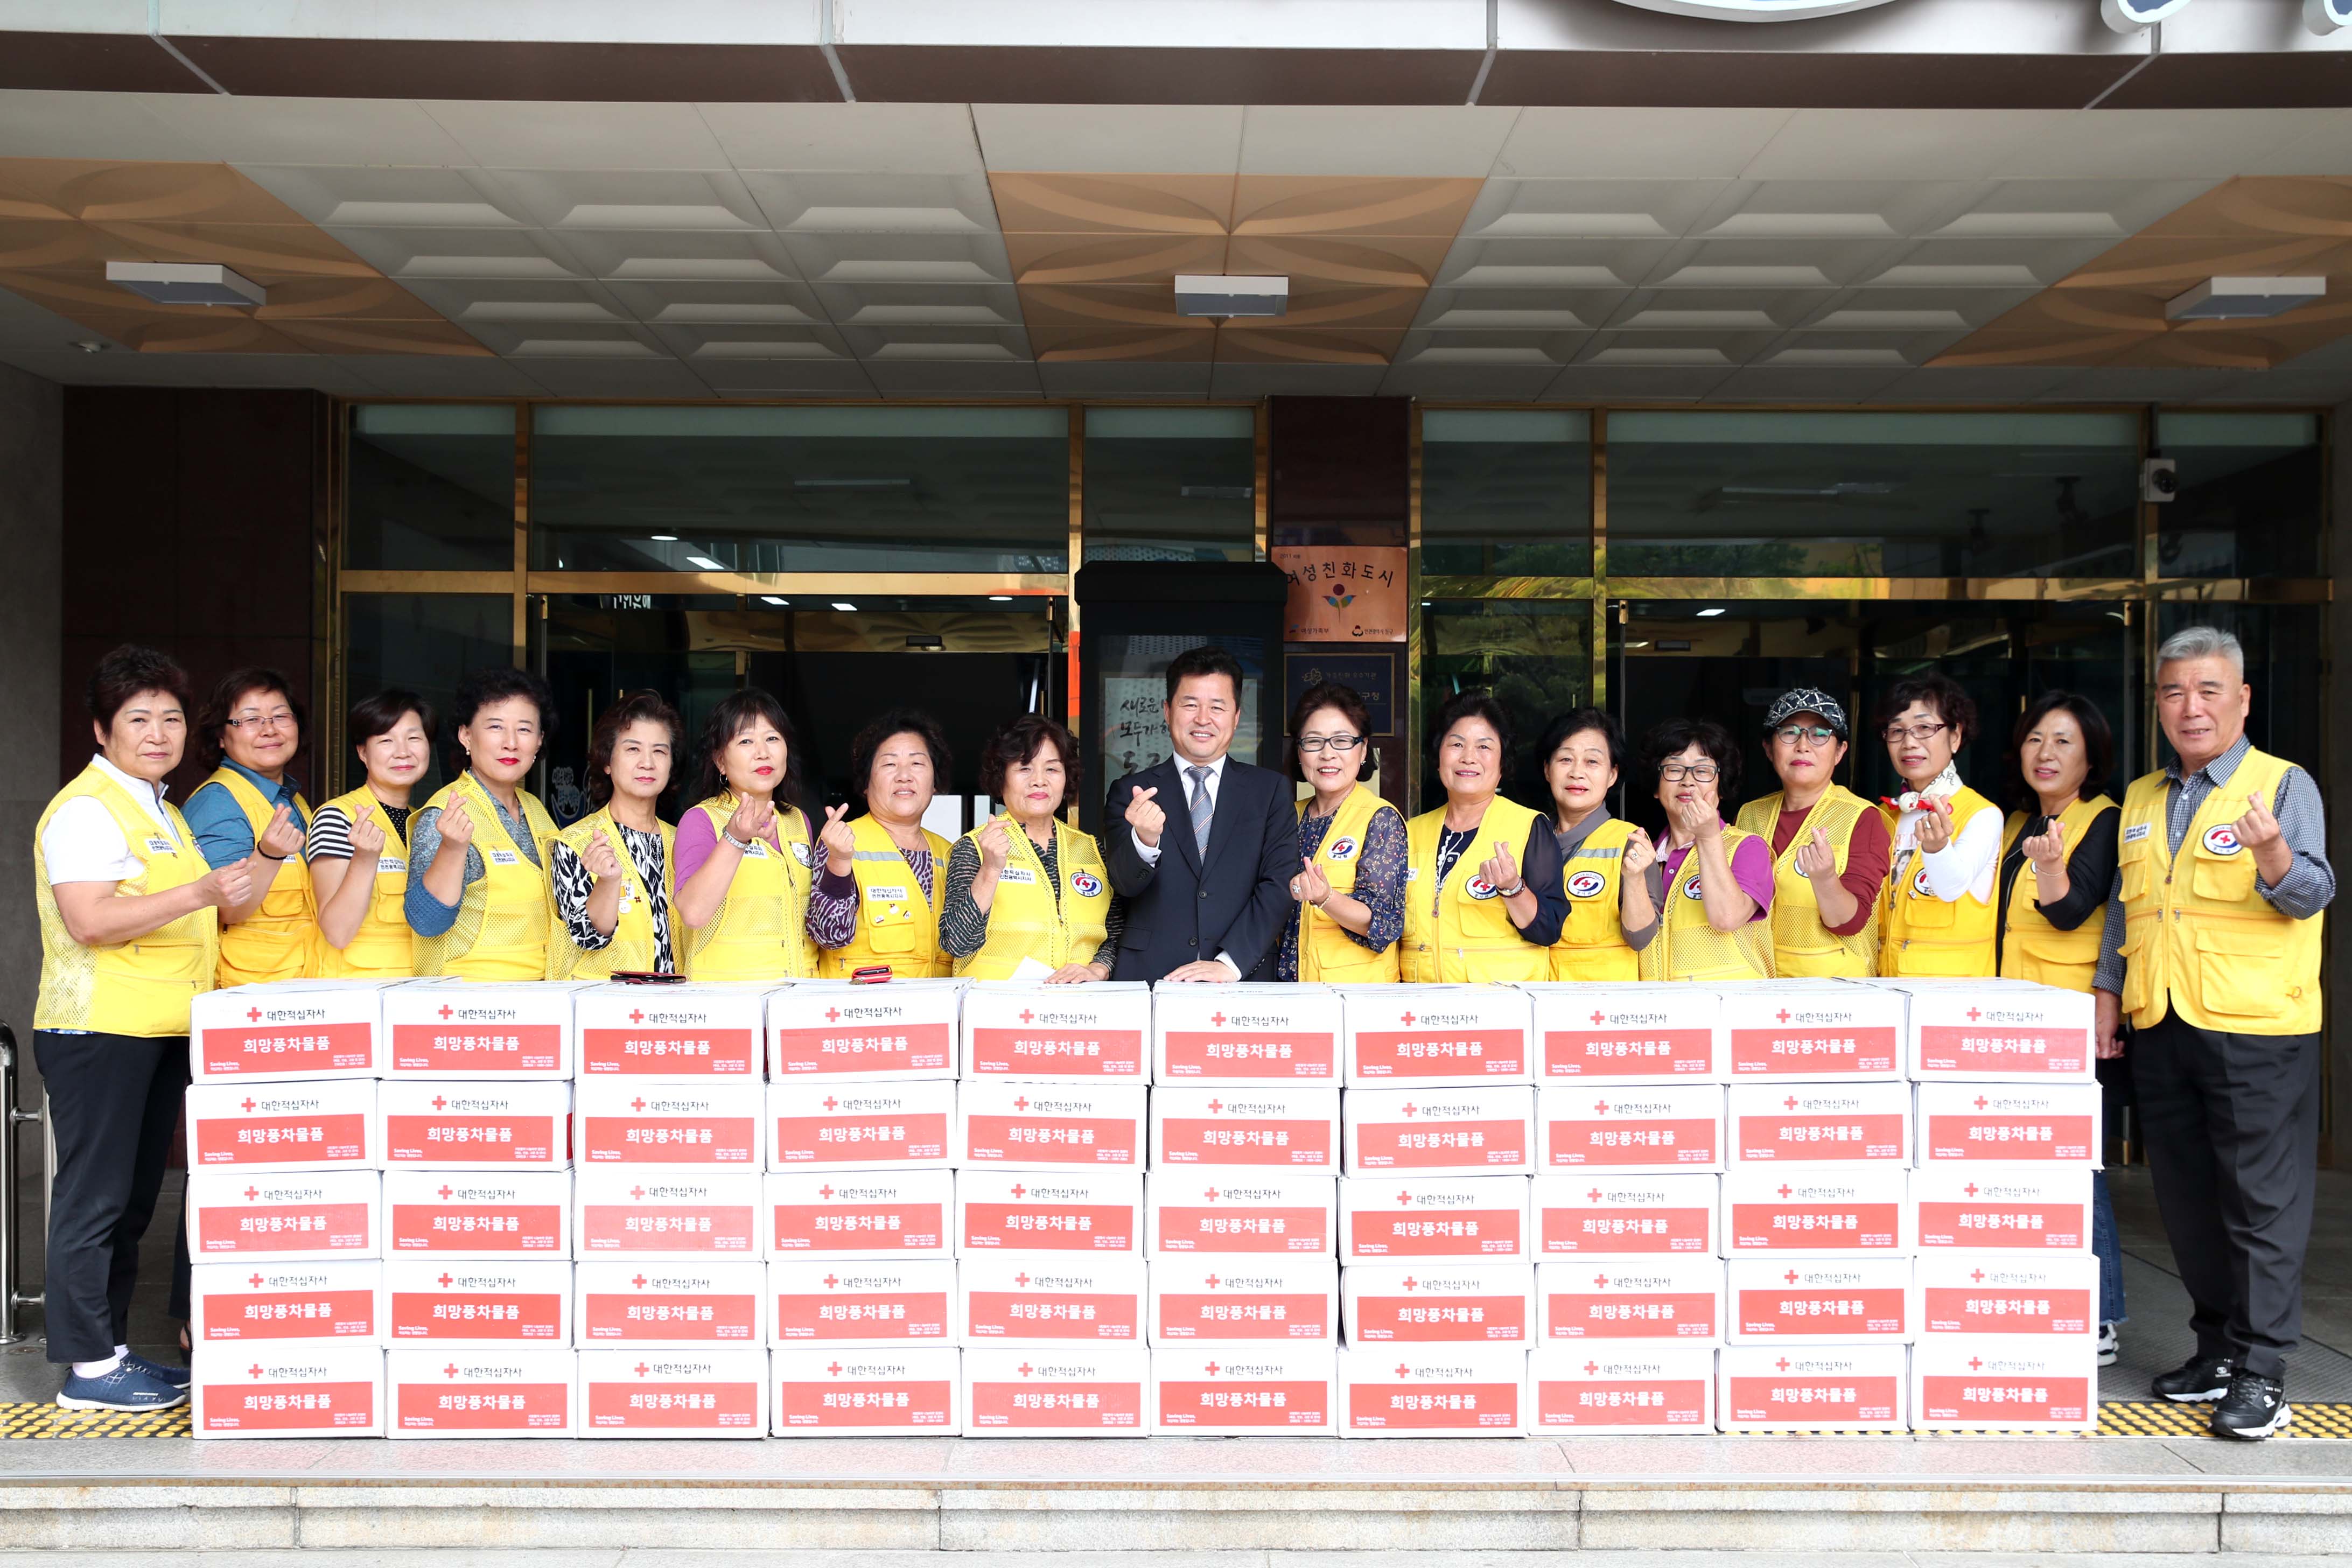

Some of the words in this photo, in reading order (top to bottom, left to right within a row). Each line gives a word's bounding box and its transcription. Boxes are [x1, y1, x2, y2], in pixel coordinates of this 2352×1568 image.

[1286, 561, 1394, 588] 여성친화도시
[1120, 697, 1159, 717] 새로운
[267, 1009, 325, 1021] 대한적십자사
[458, 1009, 516, 1020] 대한적십자사
[649, 1013, 706, 1024] 대한적십자사
[844, 1006, 902, 1019] 대한적십자사
[1039, 1013, 1097, 1024] 대한적십자사
[1421, 1014, 1479, 1025] 대한적십자사
[1610, 1014, 1667, 1024] 대한적십자사
[1796, 1012, 1852, 1023] 대한적십자사
[1986, 1011, 2043, 1021] 대한적십자사
[1231, 1016, 1289, 1026] 대한적십자사
[244, 1037, 330, 1053] 희망풍차물품
[434, 1037, 519, 1051] 희망풍차물품
[625, 1041, 710, 1055] 희망풍차물품
[822, 1037, 908, 1053] 희망풍차물품
[1014, 1040, 1100, 1055] 희망풍차물품
[1207, 1044, 1292, 1058] 희망풍차물품
[1397, 1042, 1482, 1057] 희망풍차물품
[1586, 1041, 1671, 1056] 희망풍차물품
[1772, 1039, 1856, 1054] 희망풍차물품
[1962, 1038, 2046, 1053] 희망풍차물품
[262, 1100, 319, 1111] 대한적십자사
[451, 1100, 508, 1110] 대한적십자사
[651, 1101, 709, 1111] 대한적십자사
[843, 1099, 900, 1110] 대한적십자사
[1034, 1101, 1092, 1112] 대한적십자사
[1228, 1103, 1286, 1114] 대한적십자사
[1422, 1105, 1480, 1116] 대한적십자사
[1614, 1104, 1671, 1114] 대한적십자사
[1803, 1100, 1859, 1110] 대한적십자사
[1993, 1100, 2048, 1109] 대한적십자사
[238, 1127, 323, 1143] 희망풍차물품
[428, 1128, 512, 1142] 희망풍차물품
[626, 1129, 712, 1143] 희망풍차물품
[819, 1126, 905, 1142] 희망풍차물품
[1009, 1128, 1094, 1144] 희망풍차물품
[1203, 1130, 1289, 1145] 희망풍차물품
[1398, 1132, 1484, 1148] 희망풍차물품
[1590, 1131, 1675, 1146] 희망풍차물품
[1779, 1126, 1863, 1141] 희망풍차물품
[1969, 1126, 2053, 1141] 희망풍차물품
[264, 1189, 322, 1200] 대한적십자사
[458, 1189, 515, 1200] 대한적십자사
[649, 1187, 706, 1197] 대한적십자사
[839, 1189, 896, 1199] 대한적십자사
[1031, 1188, 1089, 1199] 대한적십자사
[1223, 1189, 1281, 1199] 대한적십자사
[1608, 1192, 1664, 1202] 대한적십자사
[1798, 1188, 1854, 1198] 대한적십자사
[1984, 1187, 2040, 1197] 대한적십자사
[1417, 1195, 1474, 1205] 대한적십자사
[241, 1216, 327, 1232] 희망풍차물품
[433, 1216, 519, 1231] 희망풍차물품
[626, 1217, 711, 1231] 희망풍차물품
[815, 1216, 901, 1230] 희망풍차물품
[1006, 1215, 1091, 1230] 희망풍차물품
[1200, 1219, 1285, 1233] 희망풍차물품
[1583, 1219, 1668, 1234] 희망풍차물품
[1773, 1215, 1858, 1229] 희망풍차물품
[1958, 1214, 2043, 1229] 희망풍차물품
[1392, 1222, 1479, 1236] 희망풍차물품
[269, 1276, 327, 1287] 대한적십자사
[458, 1277, 516, 1288] 대한적십자사
[652, 1278, 710, 1289] 대한적십자사
[843, 1277, 901, 1287] 대한적십자사
[1035, 1277, 1093, 1288] 대한적십자사
[1226, 1278, 1283, 1288] 대한적십자사
[1423, 1280, 1480, 1290] 대한적십자사
[1614, 1277, 1671, 1287] 대한적십자사
[1804, 1273, 1861, 1283] 대한적십자사
[1990, 1273, 2046, 1283] 대한적십자사
[245, 1303, 332, 1319] 희망풍차물품
[433, 1305, 519, 1319] 희망풍차물품
[627, 1306, 713, 1320] 희망풍차물품
[820, 1305, 905, 1320] 희망풍차물품
[1010, 1304, 1096, 1319] 희망풍차물품
[1201, 1306, 1286, 1320] 희망풍차물품
[1589, 1305, 1674, 1319] 희망풍차물품
[1780, 1300, 1864, 1315] 희망풍차물품
[1965, 1299, 2050, 1314] 희망풍차물품
[1398, 1308, 1484, 1322] 희망풍차물품
[269, 1367, 327, 1378] 대한적십자사
[464, 1367, 522, 1377] 대한적십자사
[654, 1363, 711, 1374] 대한적십자사
[848, 1366, 905, 1376] 대한적십자사
[1038, 1366, 1096, 1377] 대한적십자사
[1226, 1366, 1283, 1375] 대한적십자사
[1415, 1368, 1473, 1378] 대한적십자사
[1604, 1364, 1661, 1374] 대한적십자사
[1795, 1361, 1852, 1371] 대한적십자사
[1988, 1361, 2045, 1371] 대한적십자사
[630, 1394, 716, 1409] 희망풍차물품
[823, 1392, 909, 1408] 희망풍차물품
[1013, 1394, 1099, 1408] 희망풍차물품
[1200, 1392, 1286, 1407] 희망풍차물품
[1579, 1391, 1664, 1406] 희망풍차물품
[1771, 1388, 1857, 1402] 희망풍차물품
[1963, 1387, 2048, 1402] 희망풍차물품
[244, 1394, 331, 1410] 희망풍차물품
[439, 1395, 526, 1410] 희망풍차물품
[1390, 1395, 1476, 1410] 희망풍차물품
